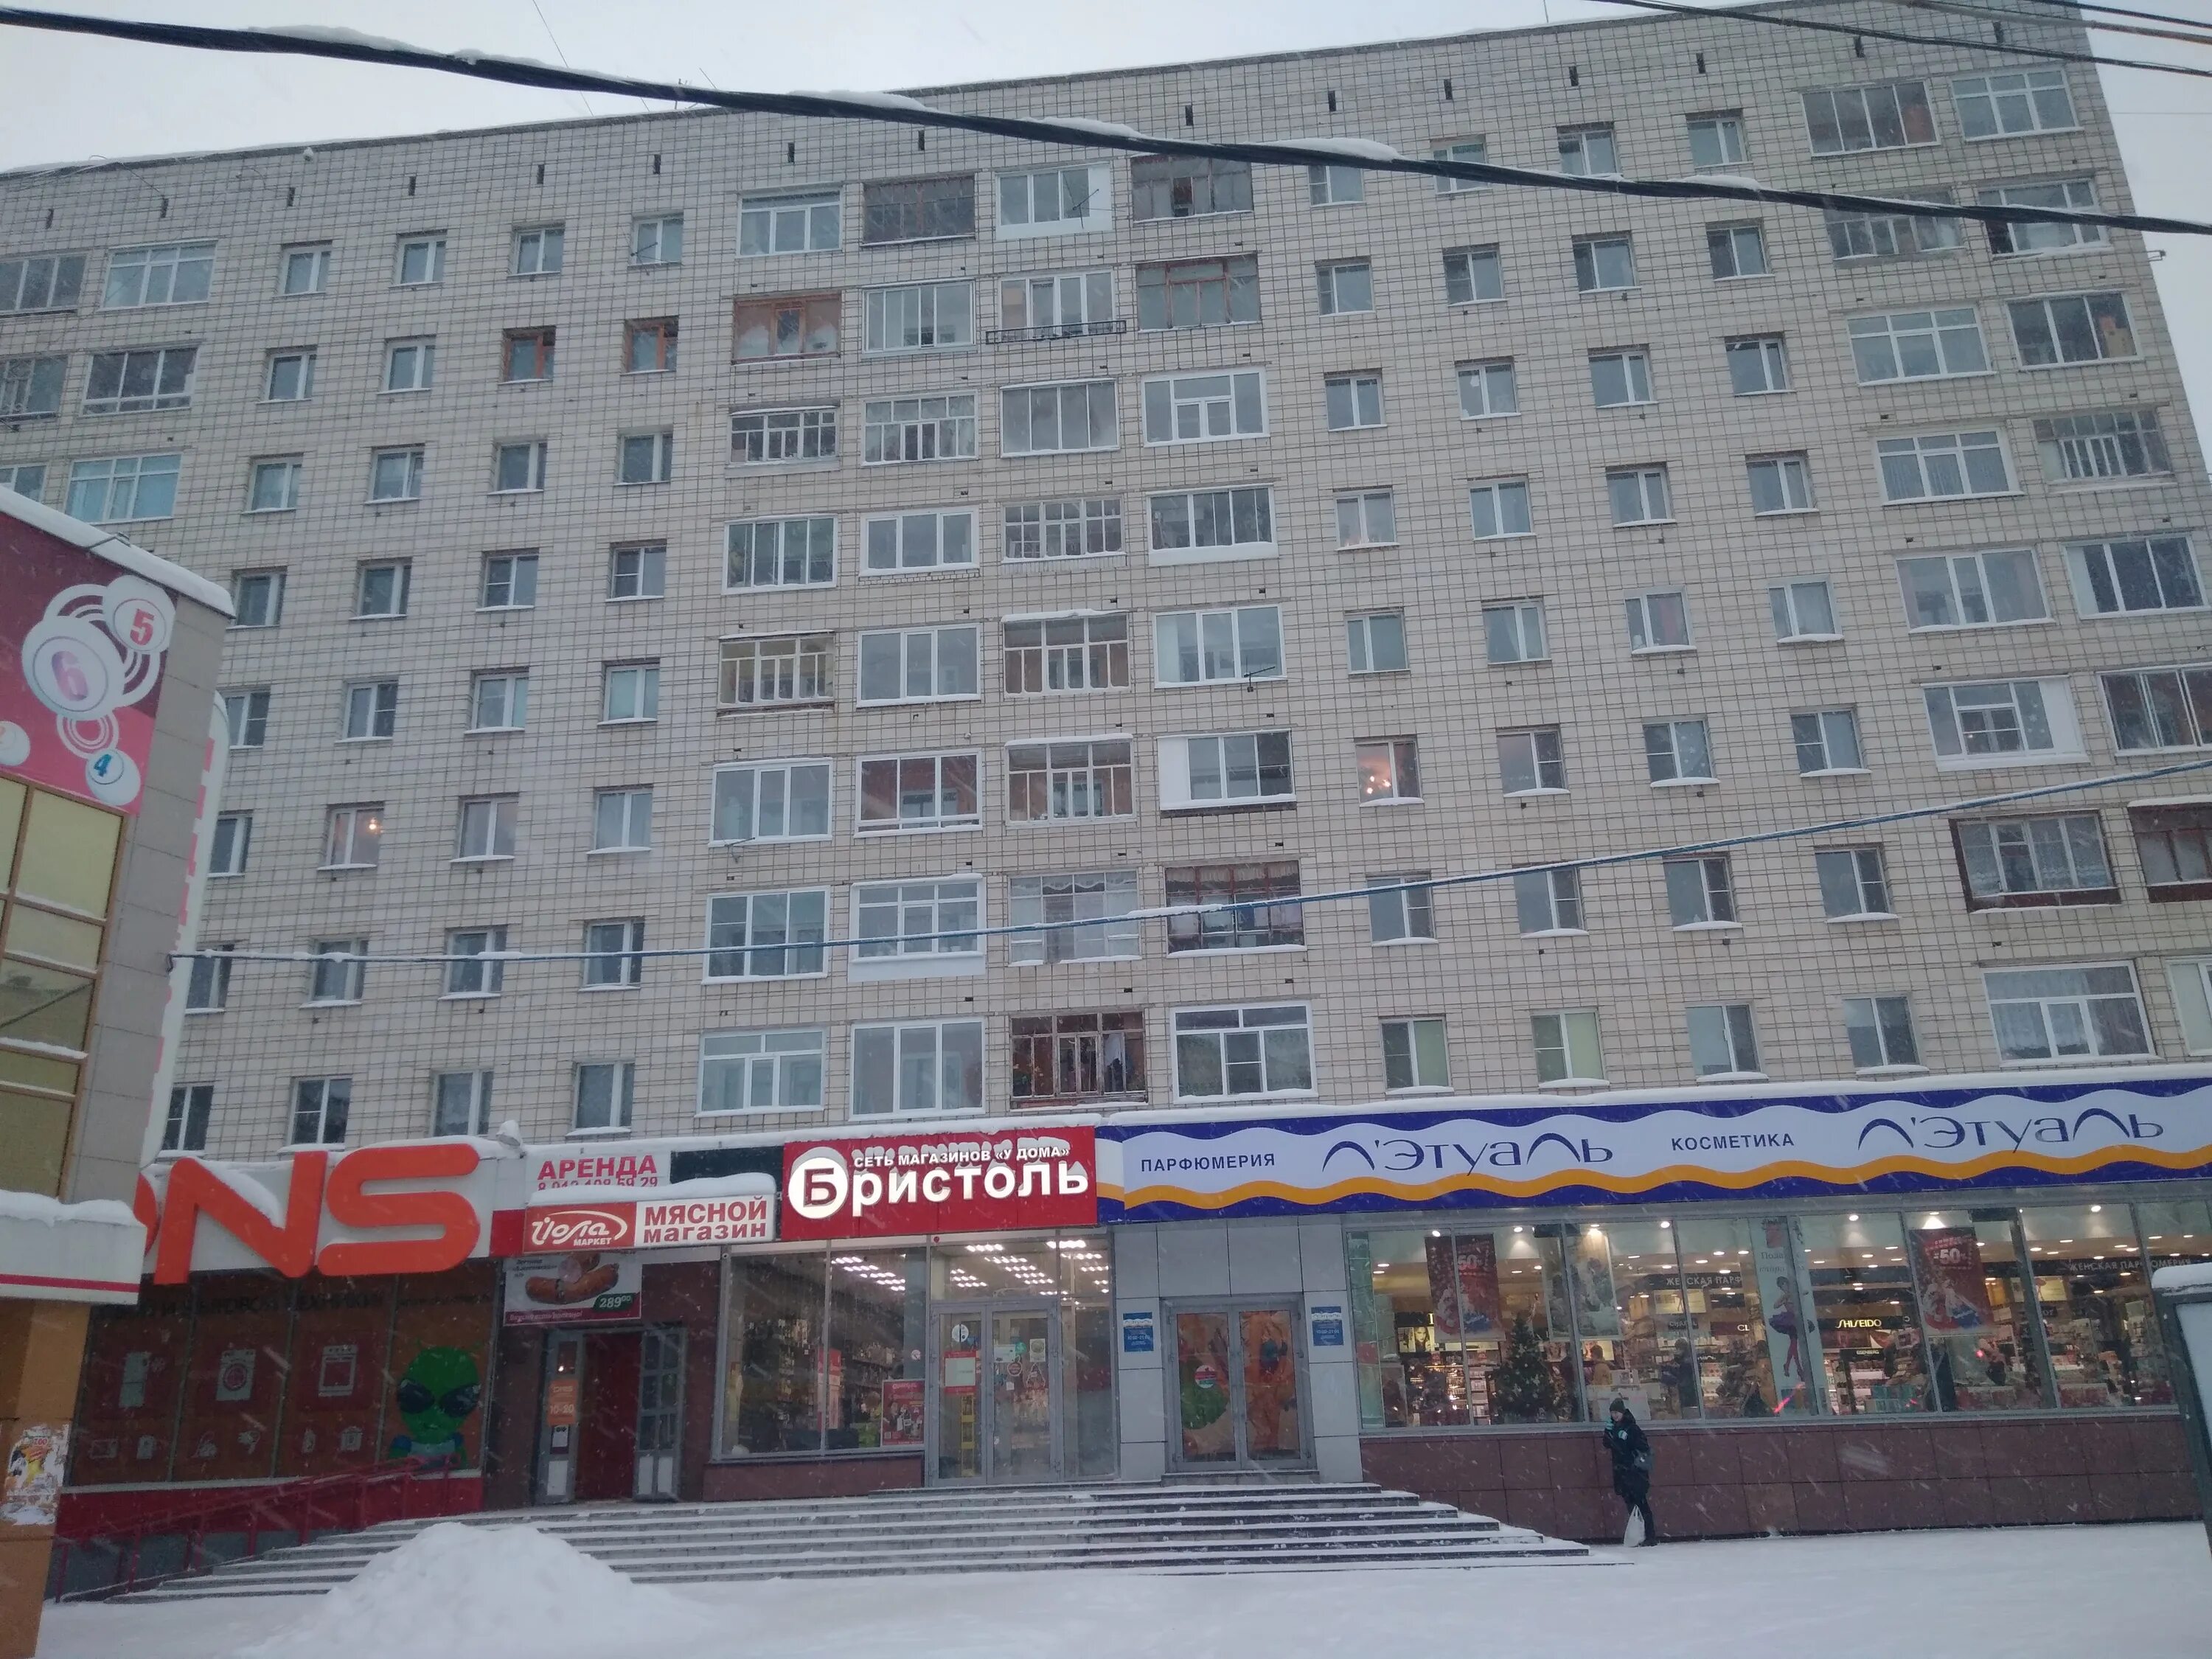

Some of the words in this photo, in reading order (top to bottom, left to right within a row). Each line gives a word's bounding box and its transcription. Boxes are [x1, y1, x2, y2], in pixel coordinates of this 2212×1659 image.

[130, 608, 154, 645] 5
[51, 650, 88, 701] 6
[94, 754, 112, 777] 4
[1671, 1133, 1795, 1152] КОСМЕТИКА
[538, 1155, 658, 1180] АРЕНДА
[854, 1155, 894, 1167] СЕТЬ
[898, 1150, 991, 1166] МАГАЗИНОВ
[1016, 1146, 1069, 1161] ДОМА»
[1140, 1152, 1276, 1172] ПАРФЮМЕРИЯ
[804, 1162, 1089, 1217] Бристоль
[644, 1196, 768, 1227] МЯСНОЙ
[573, 1237, 612, 1247] МАРКЕТ
[1666, 1276, 1713, 1286] ЖЕСКАЯ
[1835, 1319, 1882, 1328] SHISEIDO
